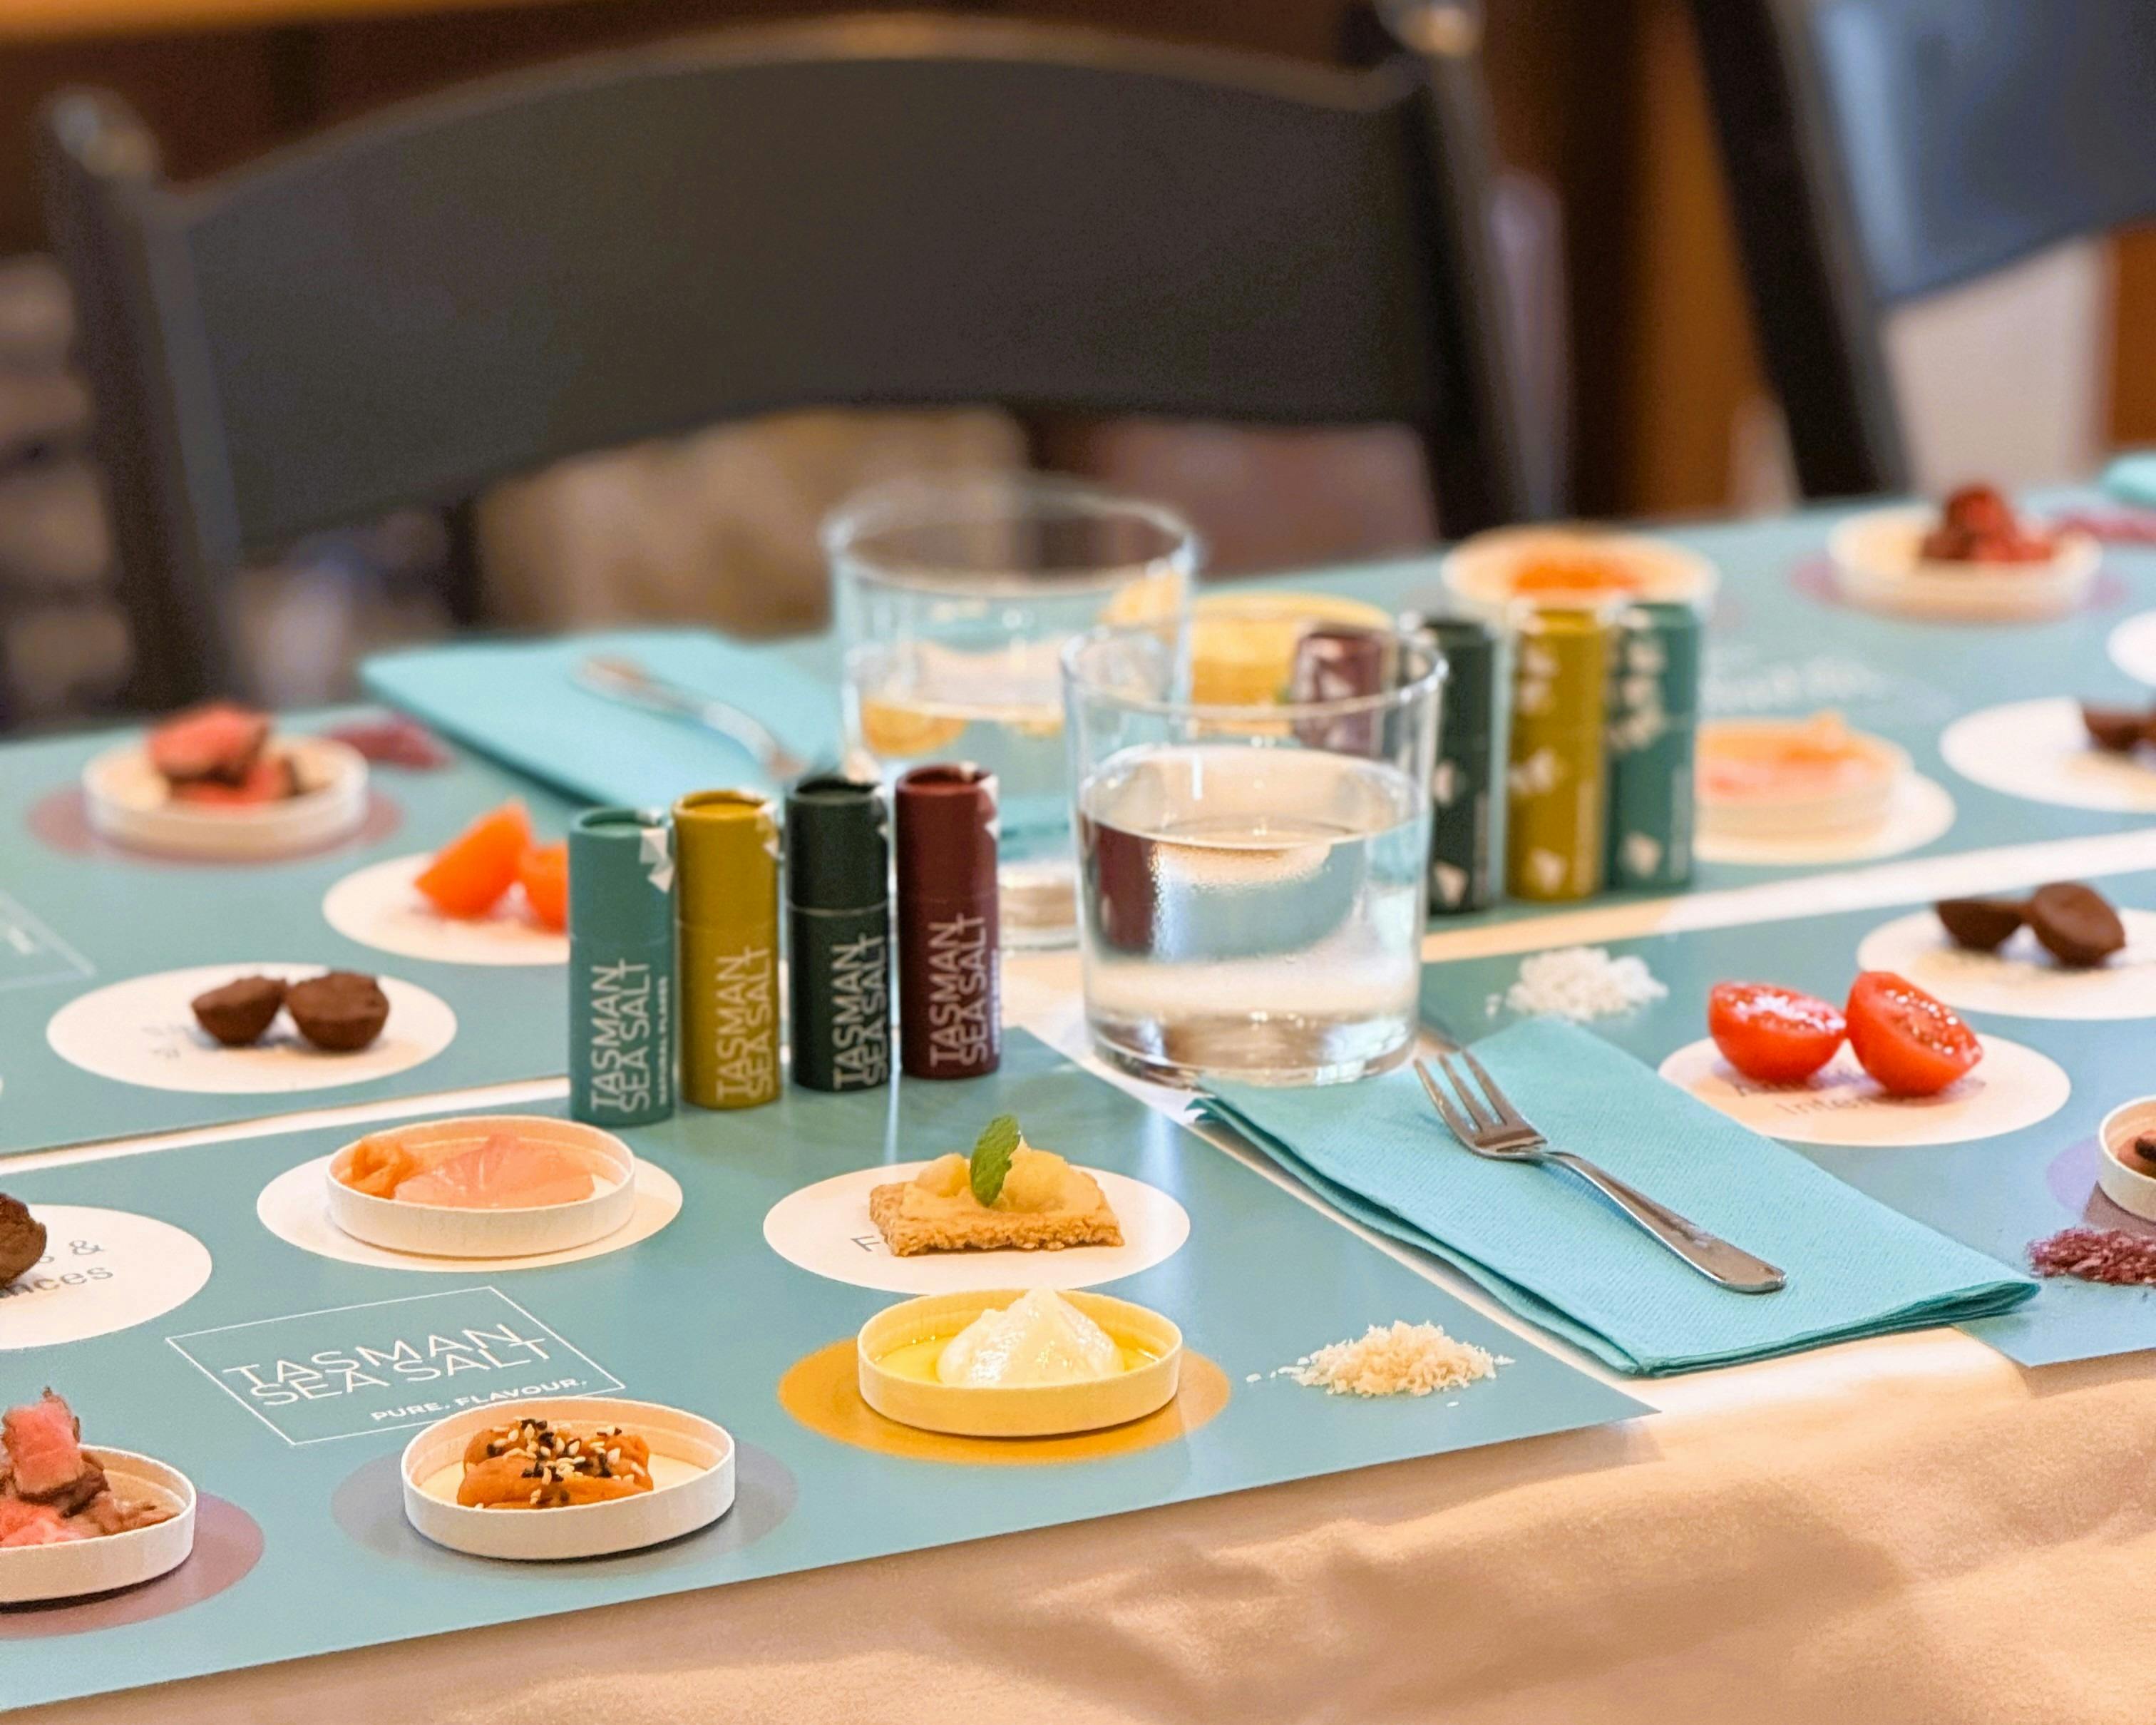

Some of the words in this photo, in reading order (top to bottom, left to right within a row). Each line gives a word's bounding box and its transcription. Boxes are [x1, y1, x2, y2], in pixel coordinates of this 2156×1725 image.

[745, 946, 772, 1028] SALT
[858, 933, 886, 1015] SALT
[957, 913, 987, 995] SALT
[618, 958, 650, 1041] SALT
[715, 956, 749, 1102] TASMAN
[831, 941, 865, 1090] TASMAN
[928, 921, 963, 1068] TASMAN
[960, 995, 988, 1066] SEA
[590, 966, 625, 1111] TASMAN
[746, 1028, 773, 1099] SEA
[860, 1015, 888, 1085] SEA
[619, 1045, 650, 1113] SEA
[68, 1239, 105, 1255] &
[222, 1324, 515, 1386] TASMAN
[249, 1369, 391, 1406] SEA
[393, 1338, 550, 1382] SALT
[370, 1401, 451, 1421] PURE.
[454, 1377, 588, 1406] FLAVOUR.
